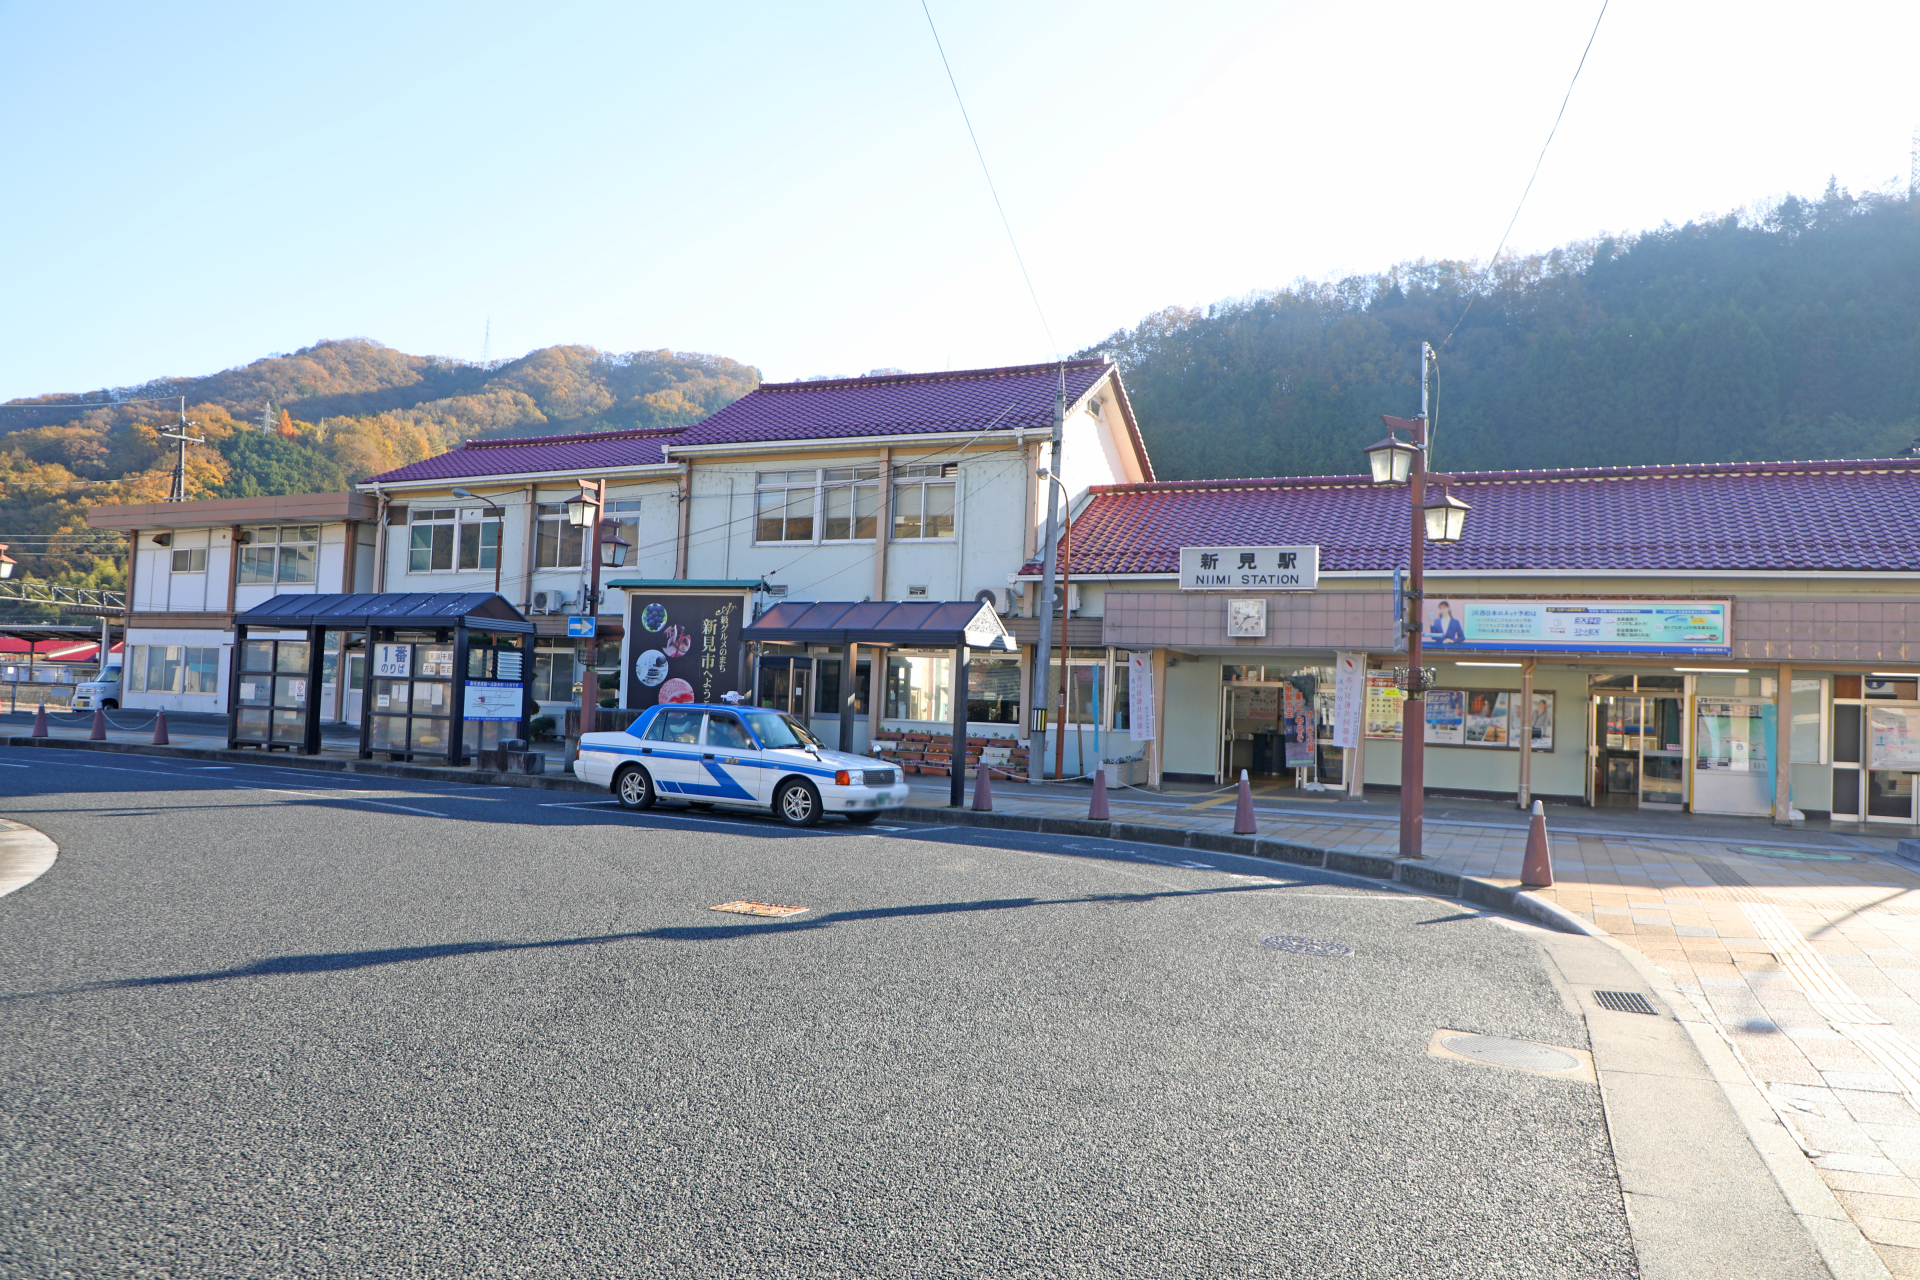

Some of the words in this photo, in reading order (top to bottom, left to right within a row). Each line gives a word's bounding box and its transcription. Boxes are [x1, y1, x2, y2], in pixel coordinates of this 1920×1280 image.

[1200, 553, 1297, 570] 新見駅
[1196, 575, 1231, 585] NIIMI
[1241, 574, 1299, 585] STATION
[715, 602, 737, 672] A級グルメのまち
[384, 646, 407, 662] 1番
[701, 619, 717, 703] 新見市へよう
[381, 664, 406, 674] のりば
